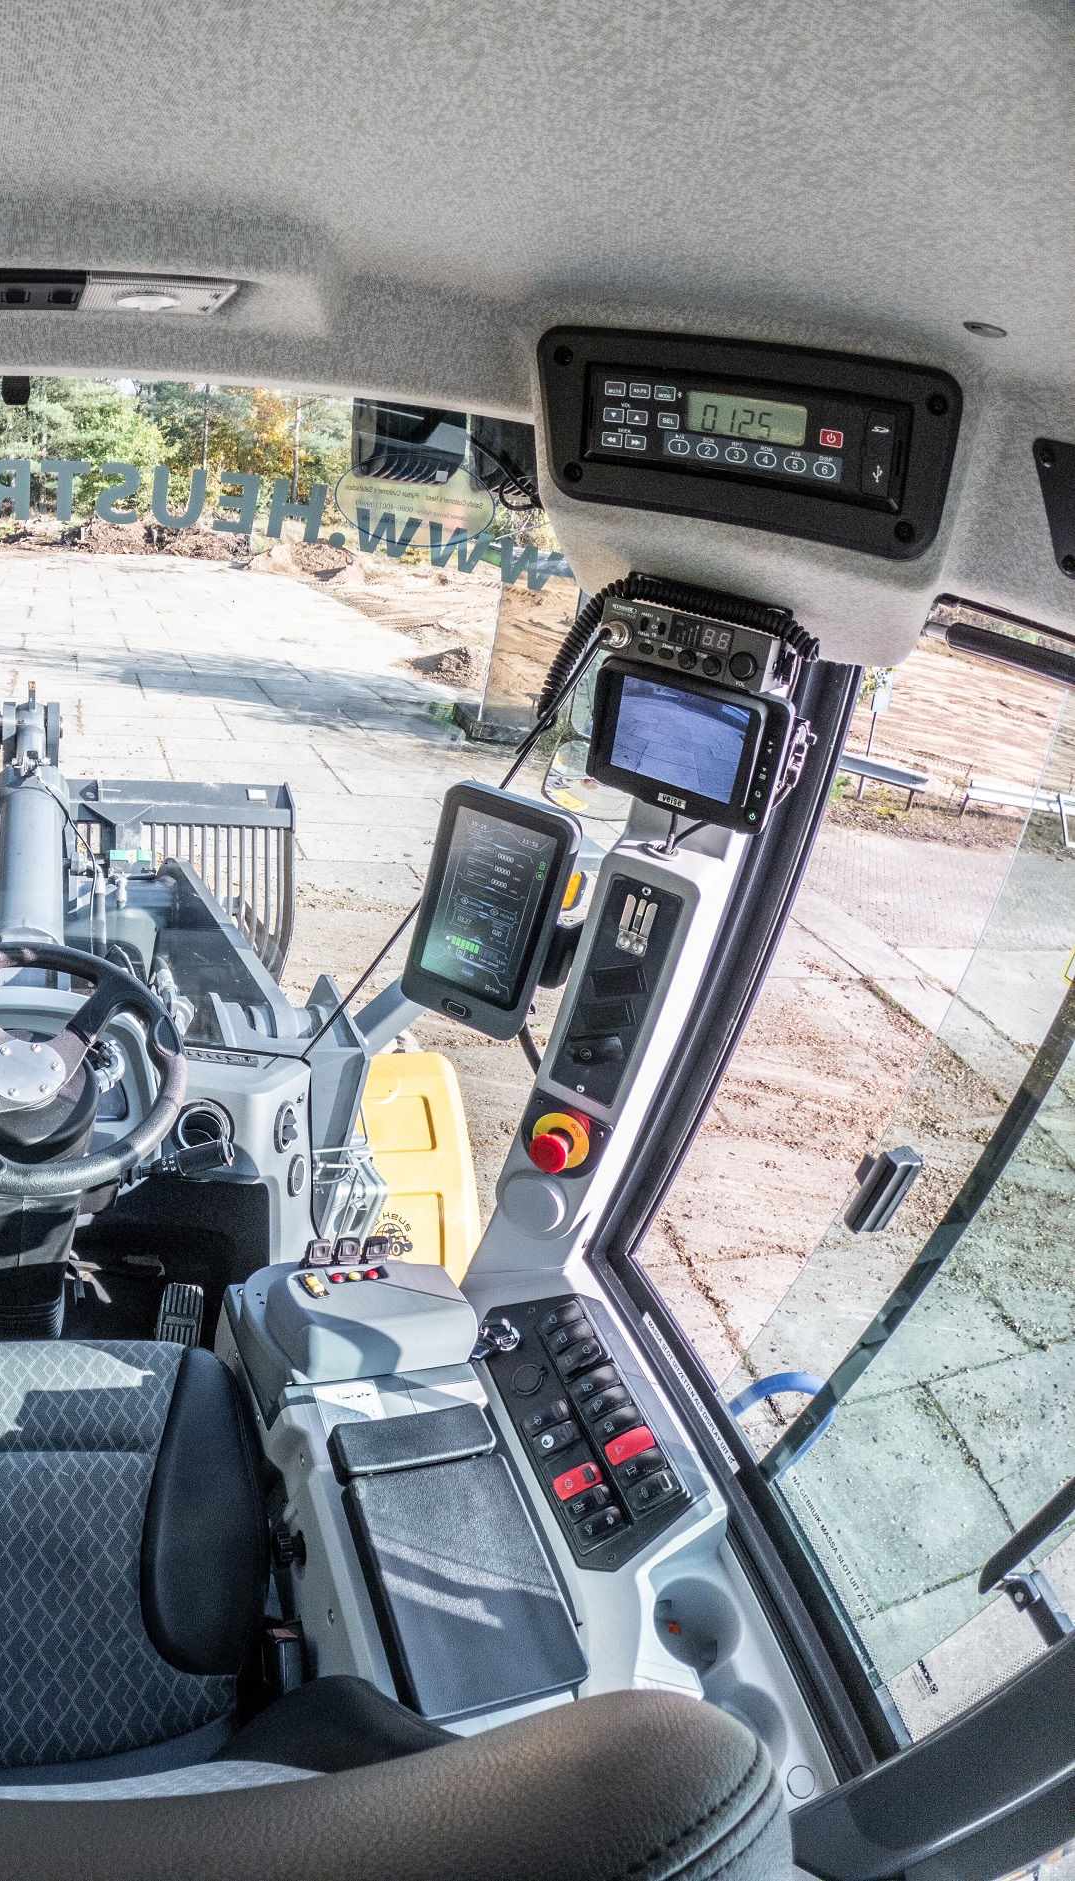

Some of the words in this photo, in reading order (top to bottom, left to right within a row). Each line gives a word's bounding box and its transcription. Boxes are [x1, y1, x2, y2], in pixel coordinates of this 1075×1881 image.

[662, 417, 675, 425] SEL
[702, 436, 715, 444] SCN
[704, 446, 711, 455] 2
[760, 445, 773, 453] RDM
[733, 450, 740, 460] 3
[762, 455, 769, 464] 4
[819, 455, 834, 463] DISP
[792, 459, 798, 469] 5
[821, 465, 828, 474] 6
[735, 680, 745, 688] VOL
[497, 852, 515, 864] 00000
[494, 865, 511, 877] 00000
[490, 878, 508, 889] 00000
[570, 1123, 584, 1138] Stop
[382, 1211, 412, 1232] Heus
[647, 1320, 663, 1344] MASSA
[661, 1343, 674, 1361] SLOT
[672, 1359, 696, 1398] UITZETTEN
[693, 1397, 705, 1412] ALS
[701, 1410, 722, 1442] DISPLAY
[720, 1440, 731, 1456] UIT
[791, 1475, 801, 1489] NA
[799, 1488, 822, 1525] GEBRUIK
[819, 1524, 839, 1555] MASSA
[836, 1554, 853, 1576] SLOT
[849, 1576, 860, 1591] UIT
[857, 1593, 876, 1622] ZETEN
